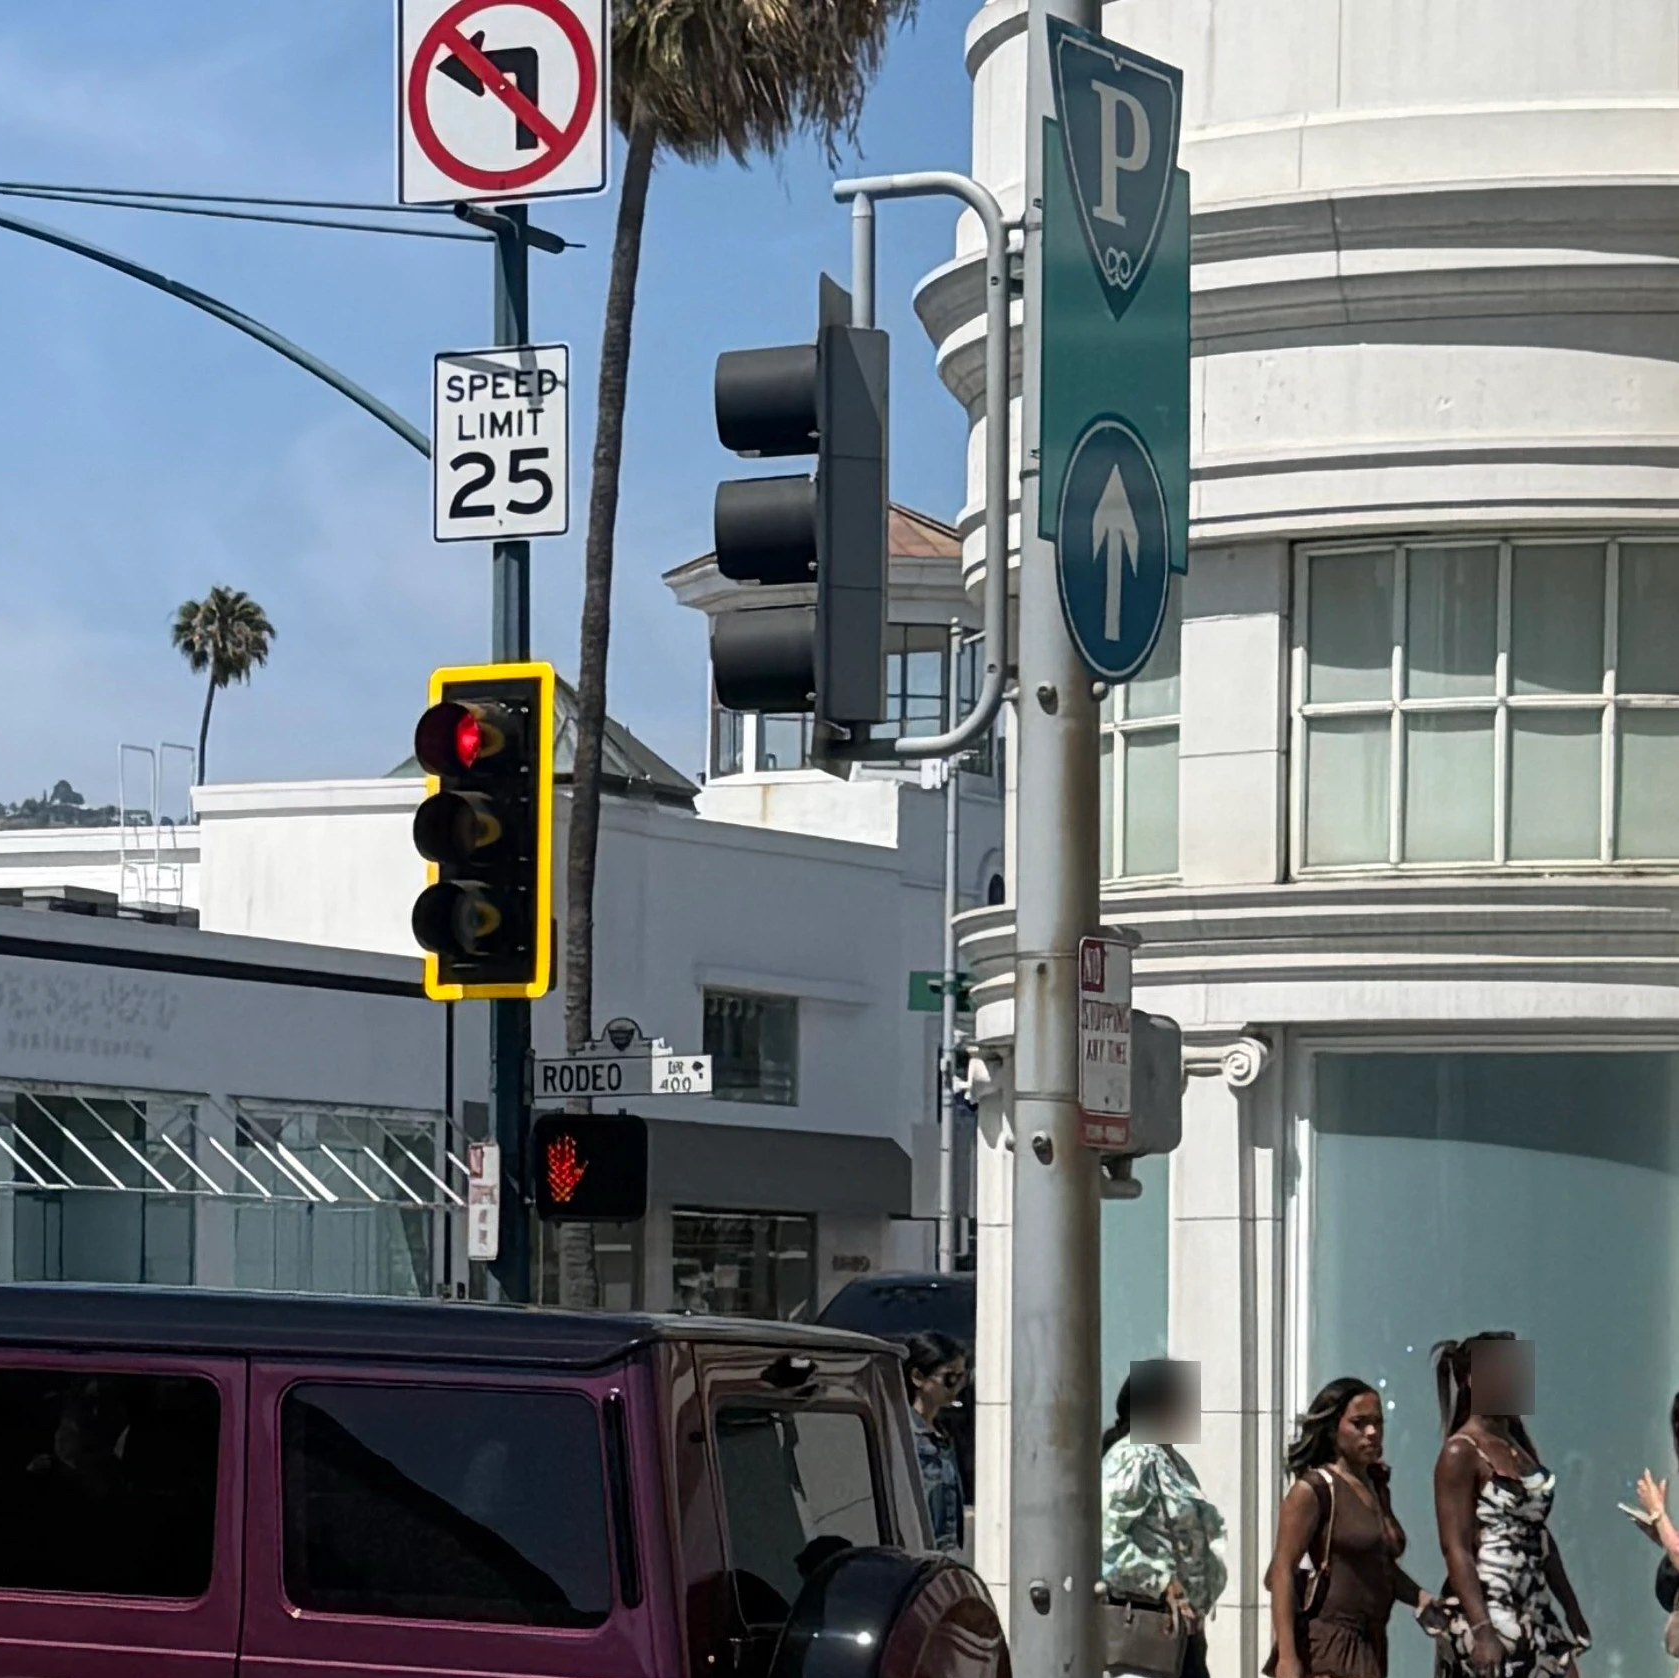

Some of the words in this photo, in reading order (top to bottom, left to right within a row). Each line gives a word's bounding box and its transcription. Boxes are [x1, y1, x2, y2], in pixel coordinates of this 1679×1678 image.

[1091, 79, 1151, 229] P
[446, 368, 558, 403] SPEED
[458, 410, 545, 441] LIMIT
[449, 447, 553, 519] 25
[543, 1063, 622, 1093] RODEO
[659, 1077, 692, 1092] 400
